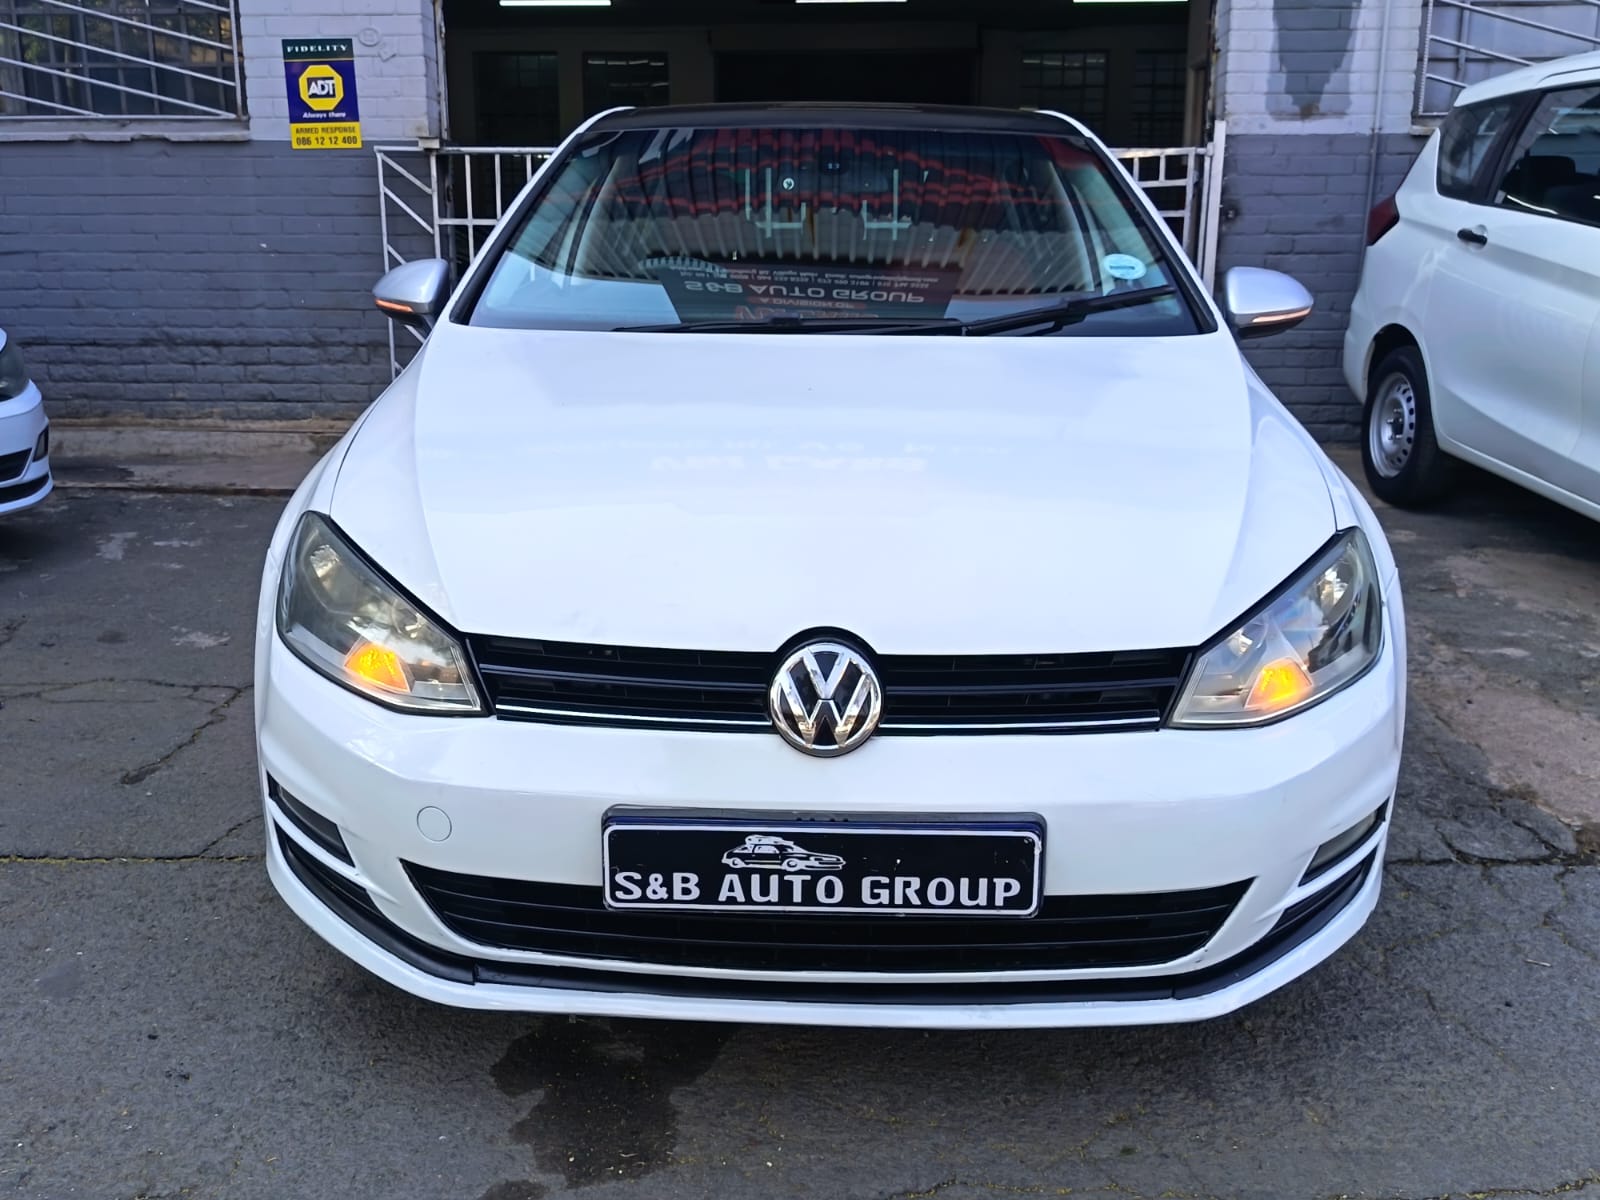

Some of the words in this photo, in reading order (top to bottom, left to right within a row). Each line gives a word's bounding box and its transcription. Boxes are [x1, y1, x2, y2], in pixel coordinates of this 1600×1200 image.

[286, 44, 348, 53] FIDELITY
[308, 79, 336, 96] ADT
[296, 136, 312, 146] 086
[315, 136, 326, 145] 12
[329, 136, 339, 145] 12
[342, 135, 358, 144] 400
[613, 872, 701, 902] S&B
[717, 873, 845, 905] AUTO
[861, 876, 1022, 907] GROUP
